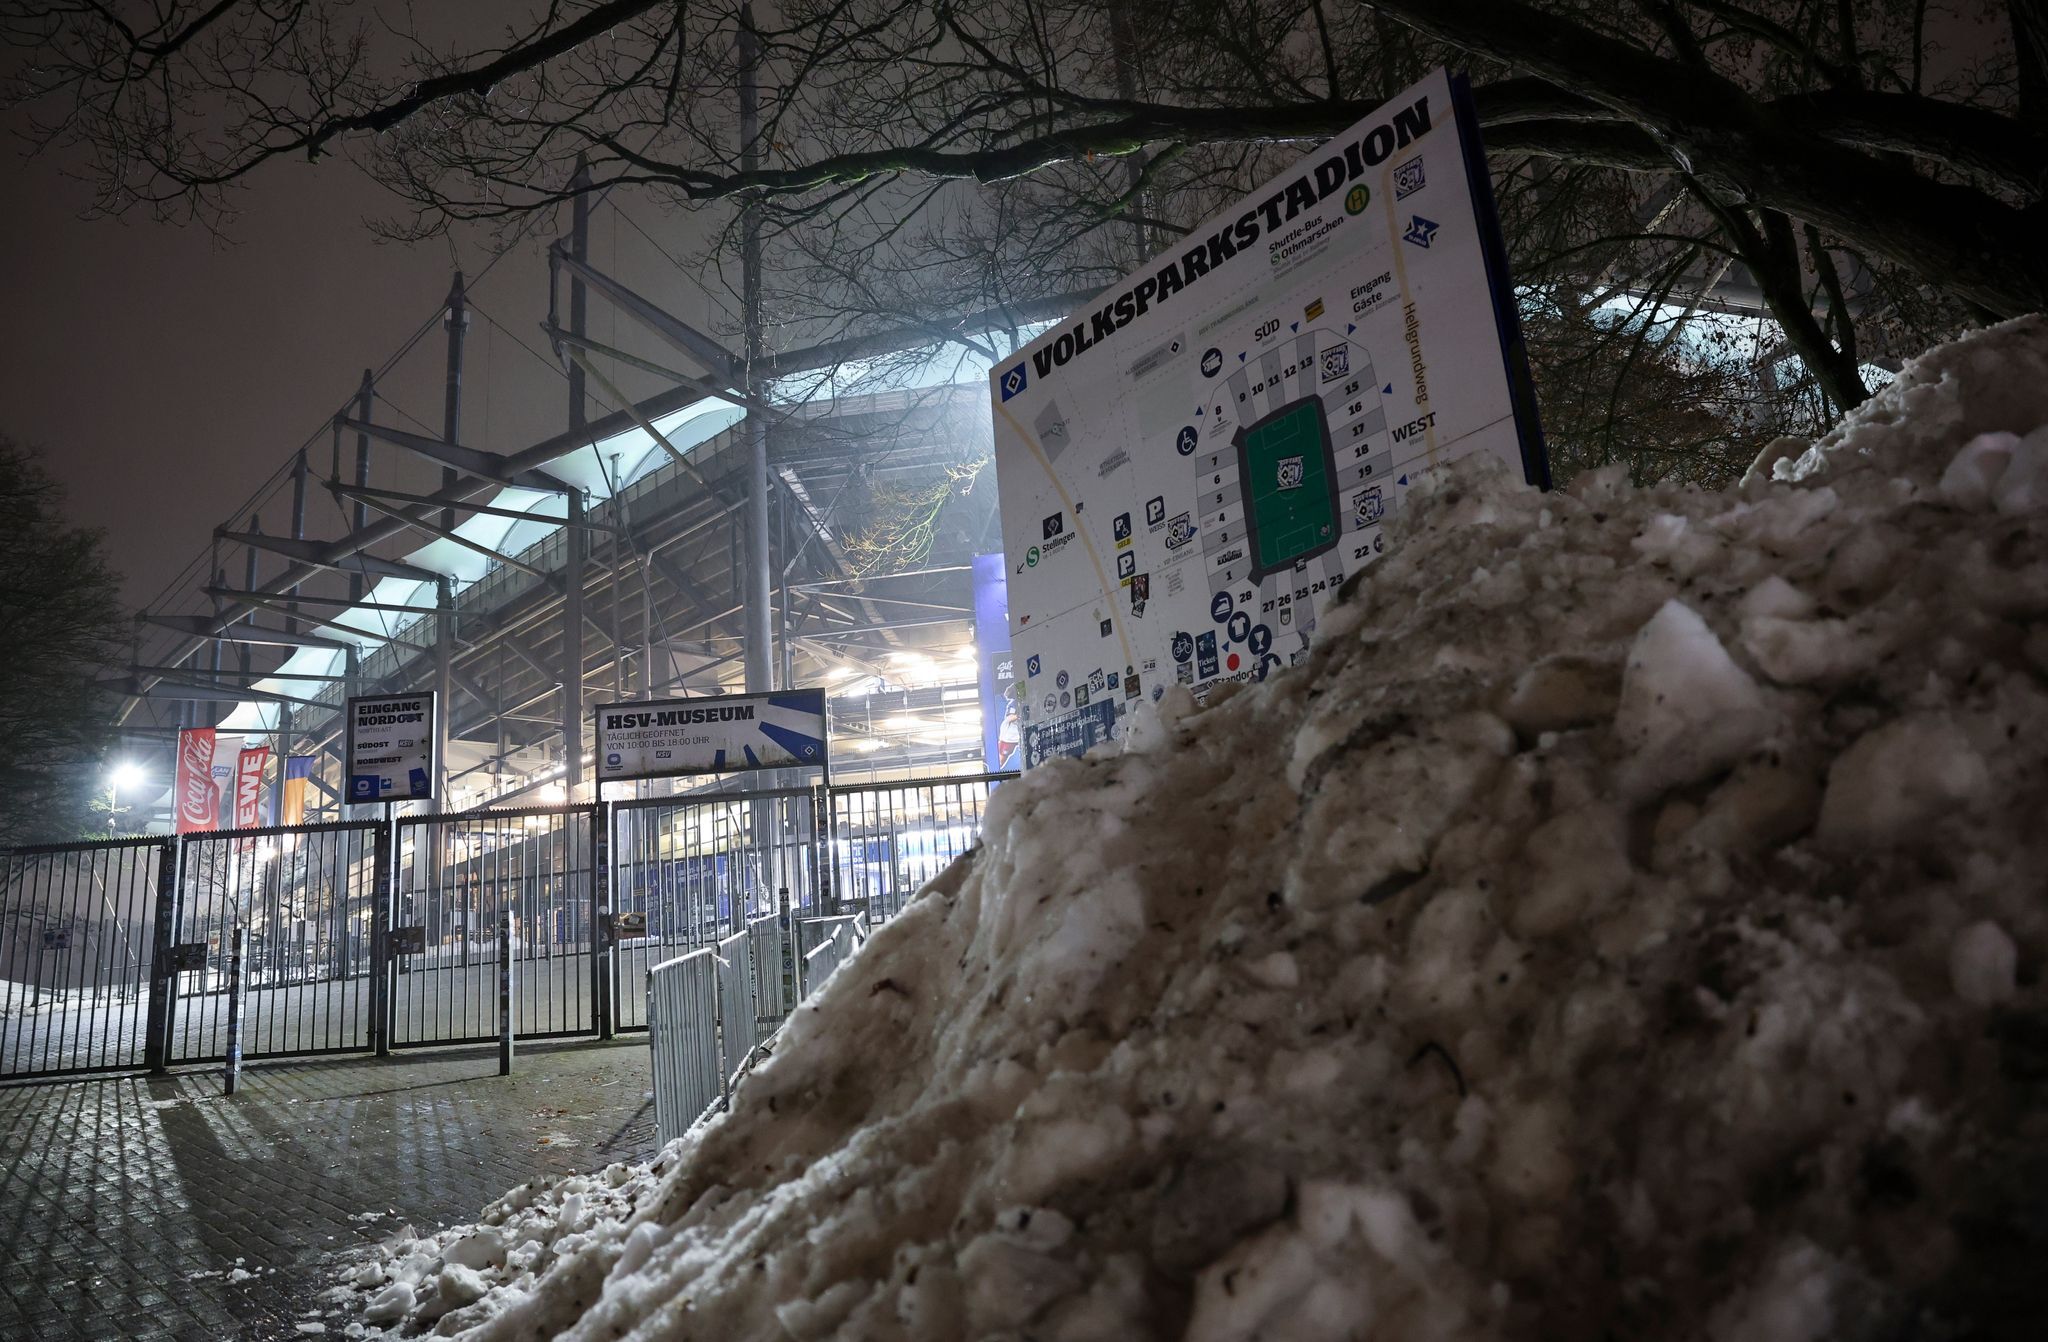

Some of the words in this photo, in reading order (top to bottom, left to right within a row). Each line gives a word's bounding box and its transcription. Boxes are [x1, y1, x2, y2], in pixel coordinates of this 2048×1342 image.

[1033, 97, 1432, 379] VOLKSPARKSTADION
[1269, 216, 1322, 253] Shuttle-Bus
[1282, 216, 1344, 258] Othmarschen
[1351, 271, 1391, 299] Eingang
[1353, 292, 1382, 312] Gäste
[1254, 319, 1280, 342] SÜD
[1404, 302, 1428, 404] Hellgrundweg
[1299, 356, 1313, 370] 13
[1283, 366, 1297, 378] 12
[1267, 375, 1281, 387] 11
[1251, 384, 1264, 396] 10
[1344, 382, 1359, 395] 15
[1239, 393, 1246, 402] 9
[1215, 405, 1222, 415] 8
[1348, 402, 1362, 416] 16
[1352, 423, 1365, 437] 17
[1392, 412, 1436, 443] WEST
[1355, 444, 1369, 458] 18
[1211, 457, 1218, 466] 7
[1358, 465, 1372, 479] 19
[1213, 475, 1220, 484] 6
[1216, 493, 1223, 503] 5
[1219, 512, 1226, 522] 4
[1149, 522, 1166, 534] WEISS
[1042, 531, 1076, 554] Stellingen
[1221, 533, 1228, 542] 3
[1354, 546, 1369, 559] 22
[1226, 571, 1232, 581] 1
[1330, 574, 1344, 587] 23
[1295, 587, 1309, 600] 25
[1312, 581, 1326, 594] 24
[1239, 591, 1252, 603] 28
[1278, 594, 1291, 607] 26
[1262, 601, 1275, 613] 27
[358, 702, 420, 715] EINGANG
[607, 705, 754, 730] HSV-MUSEUM
[357, 741, 389, 749] SÜDOST
[607, 742, 625, 751] VON
[652, 739, 665, 748] BIS
[692, 736, 710, 745] UHR
[357, 756, 402, 765] NORDWEST
[181, 731, 213, 826] Coca-Cola
[239, 752, 264, 826] EWE
